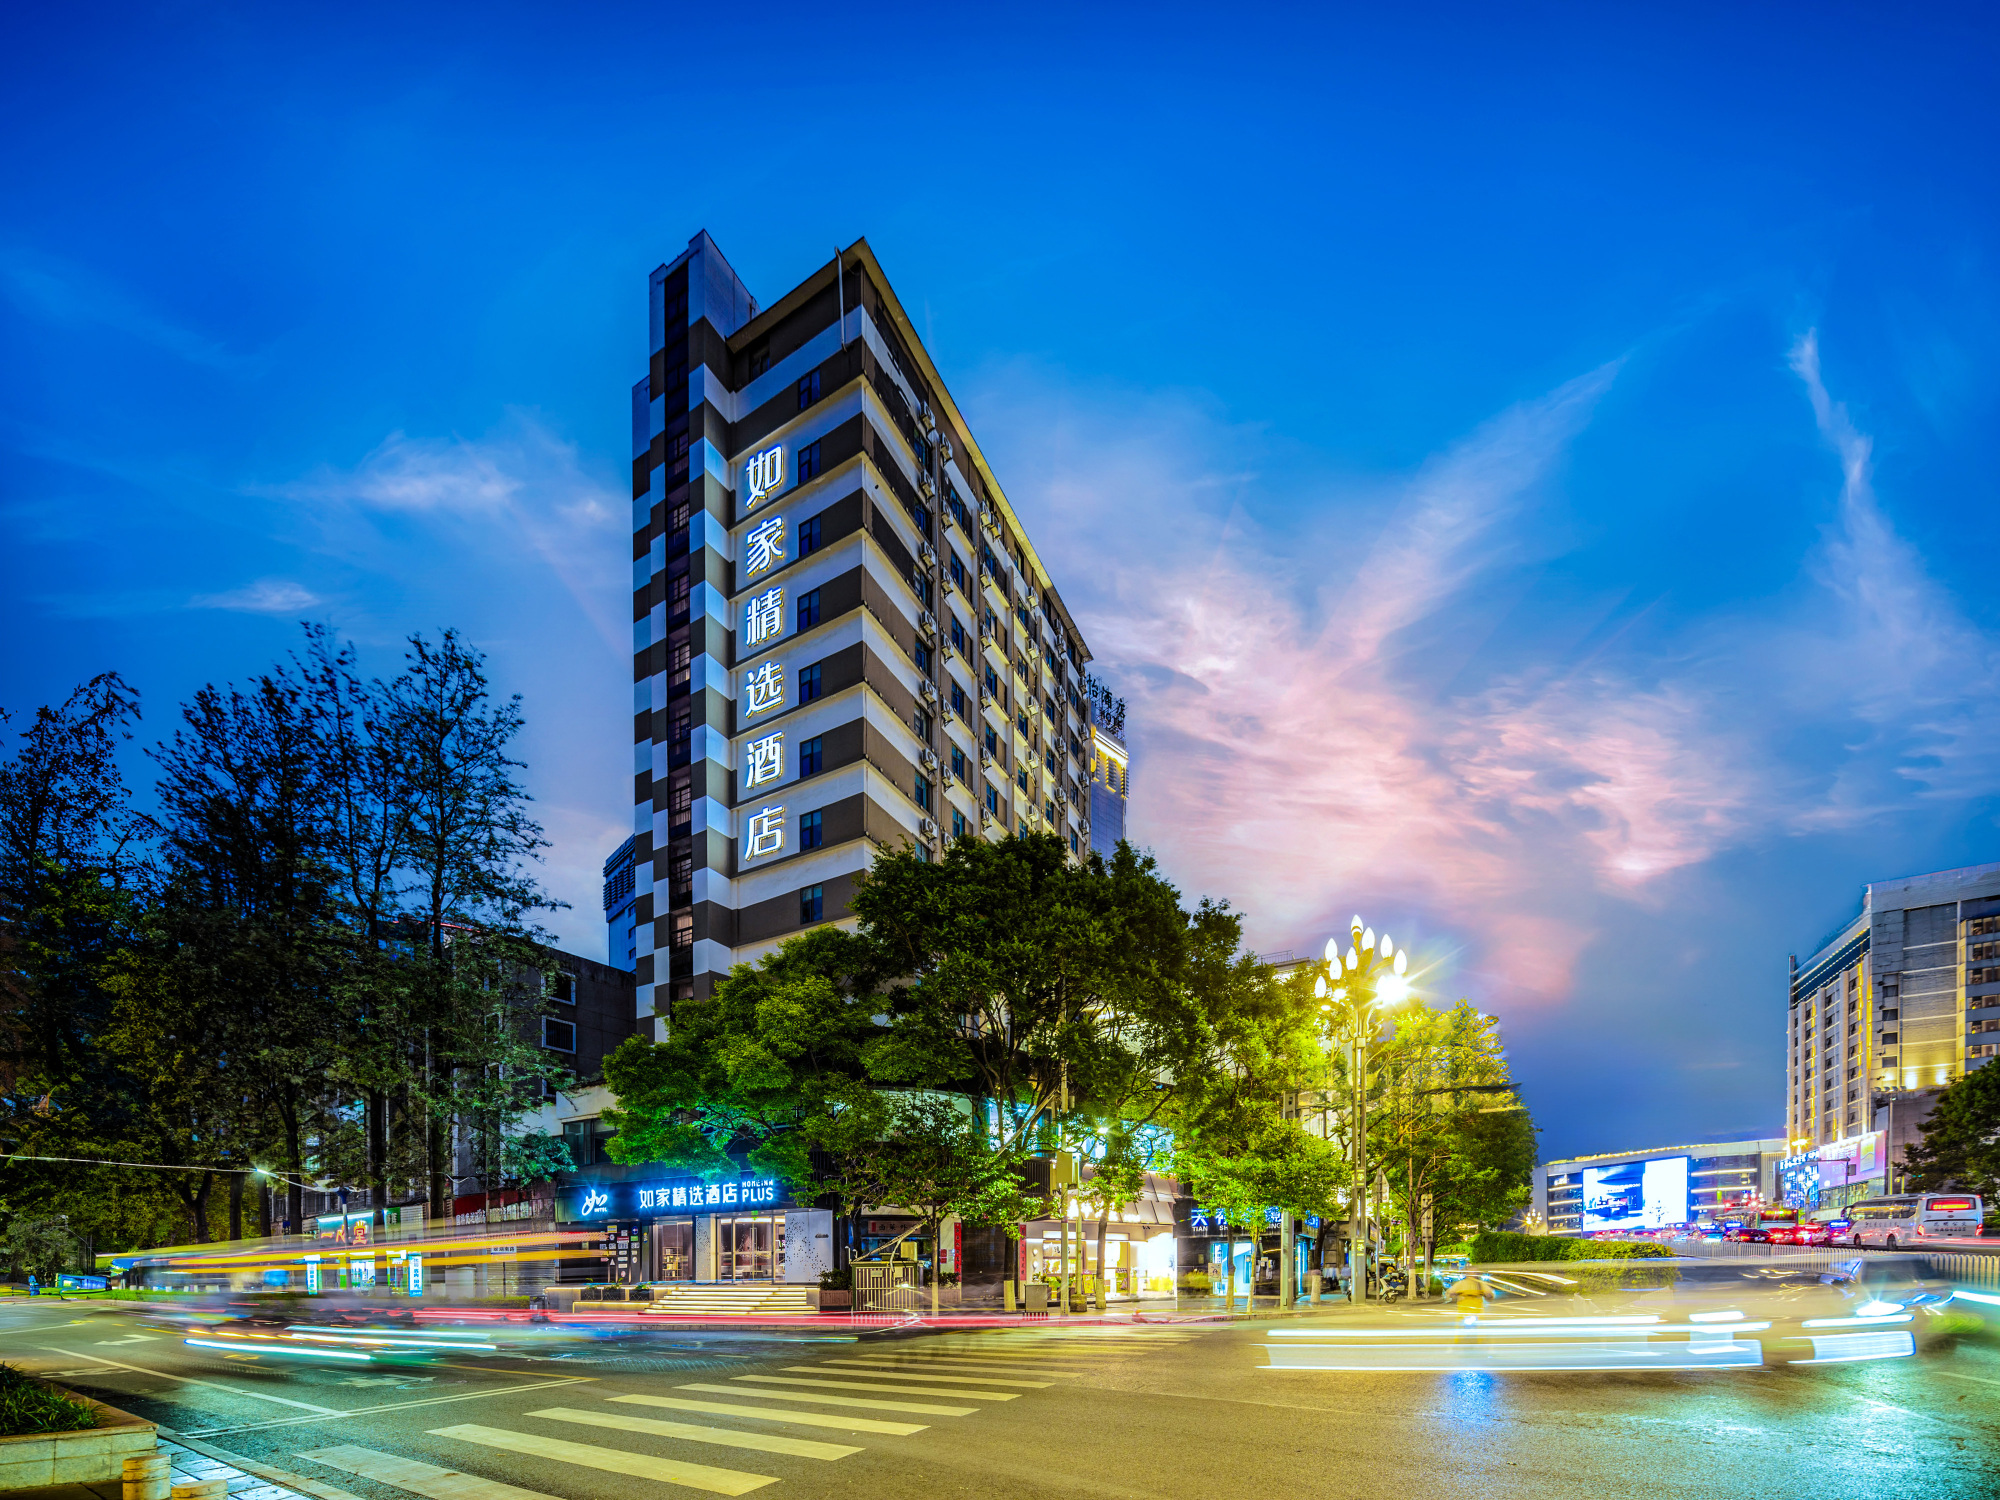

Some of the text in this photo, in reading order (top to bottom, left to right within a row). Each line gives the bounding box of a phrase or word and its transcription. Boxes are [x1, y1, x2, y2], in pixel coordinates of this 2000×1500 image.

[745, 444, 785, 861] 如家精选酒店
[639, 1182, 737, 1209] 如家精选酒店
[742, 1187, 773, 1203] PLUS
